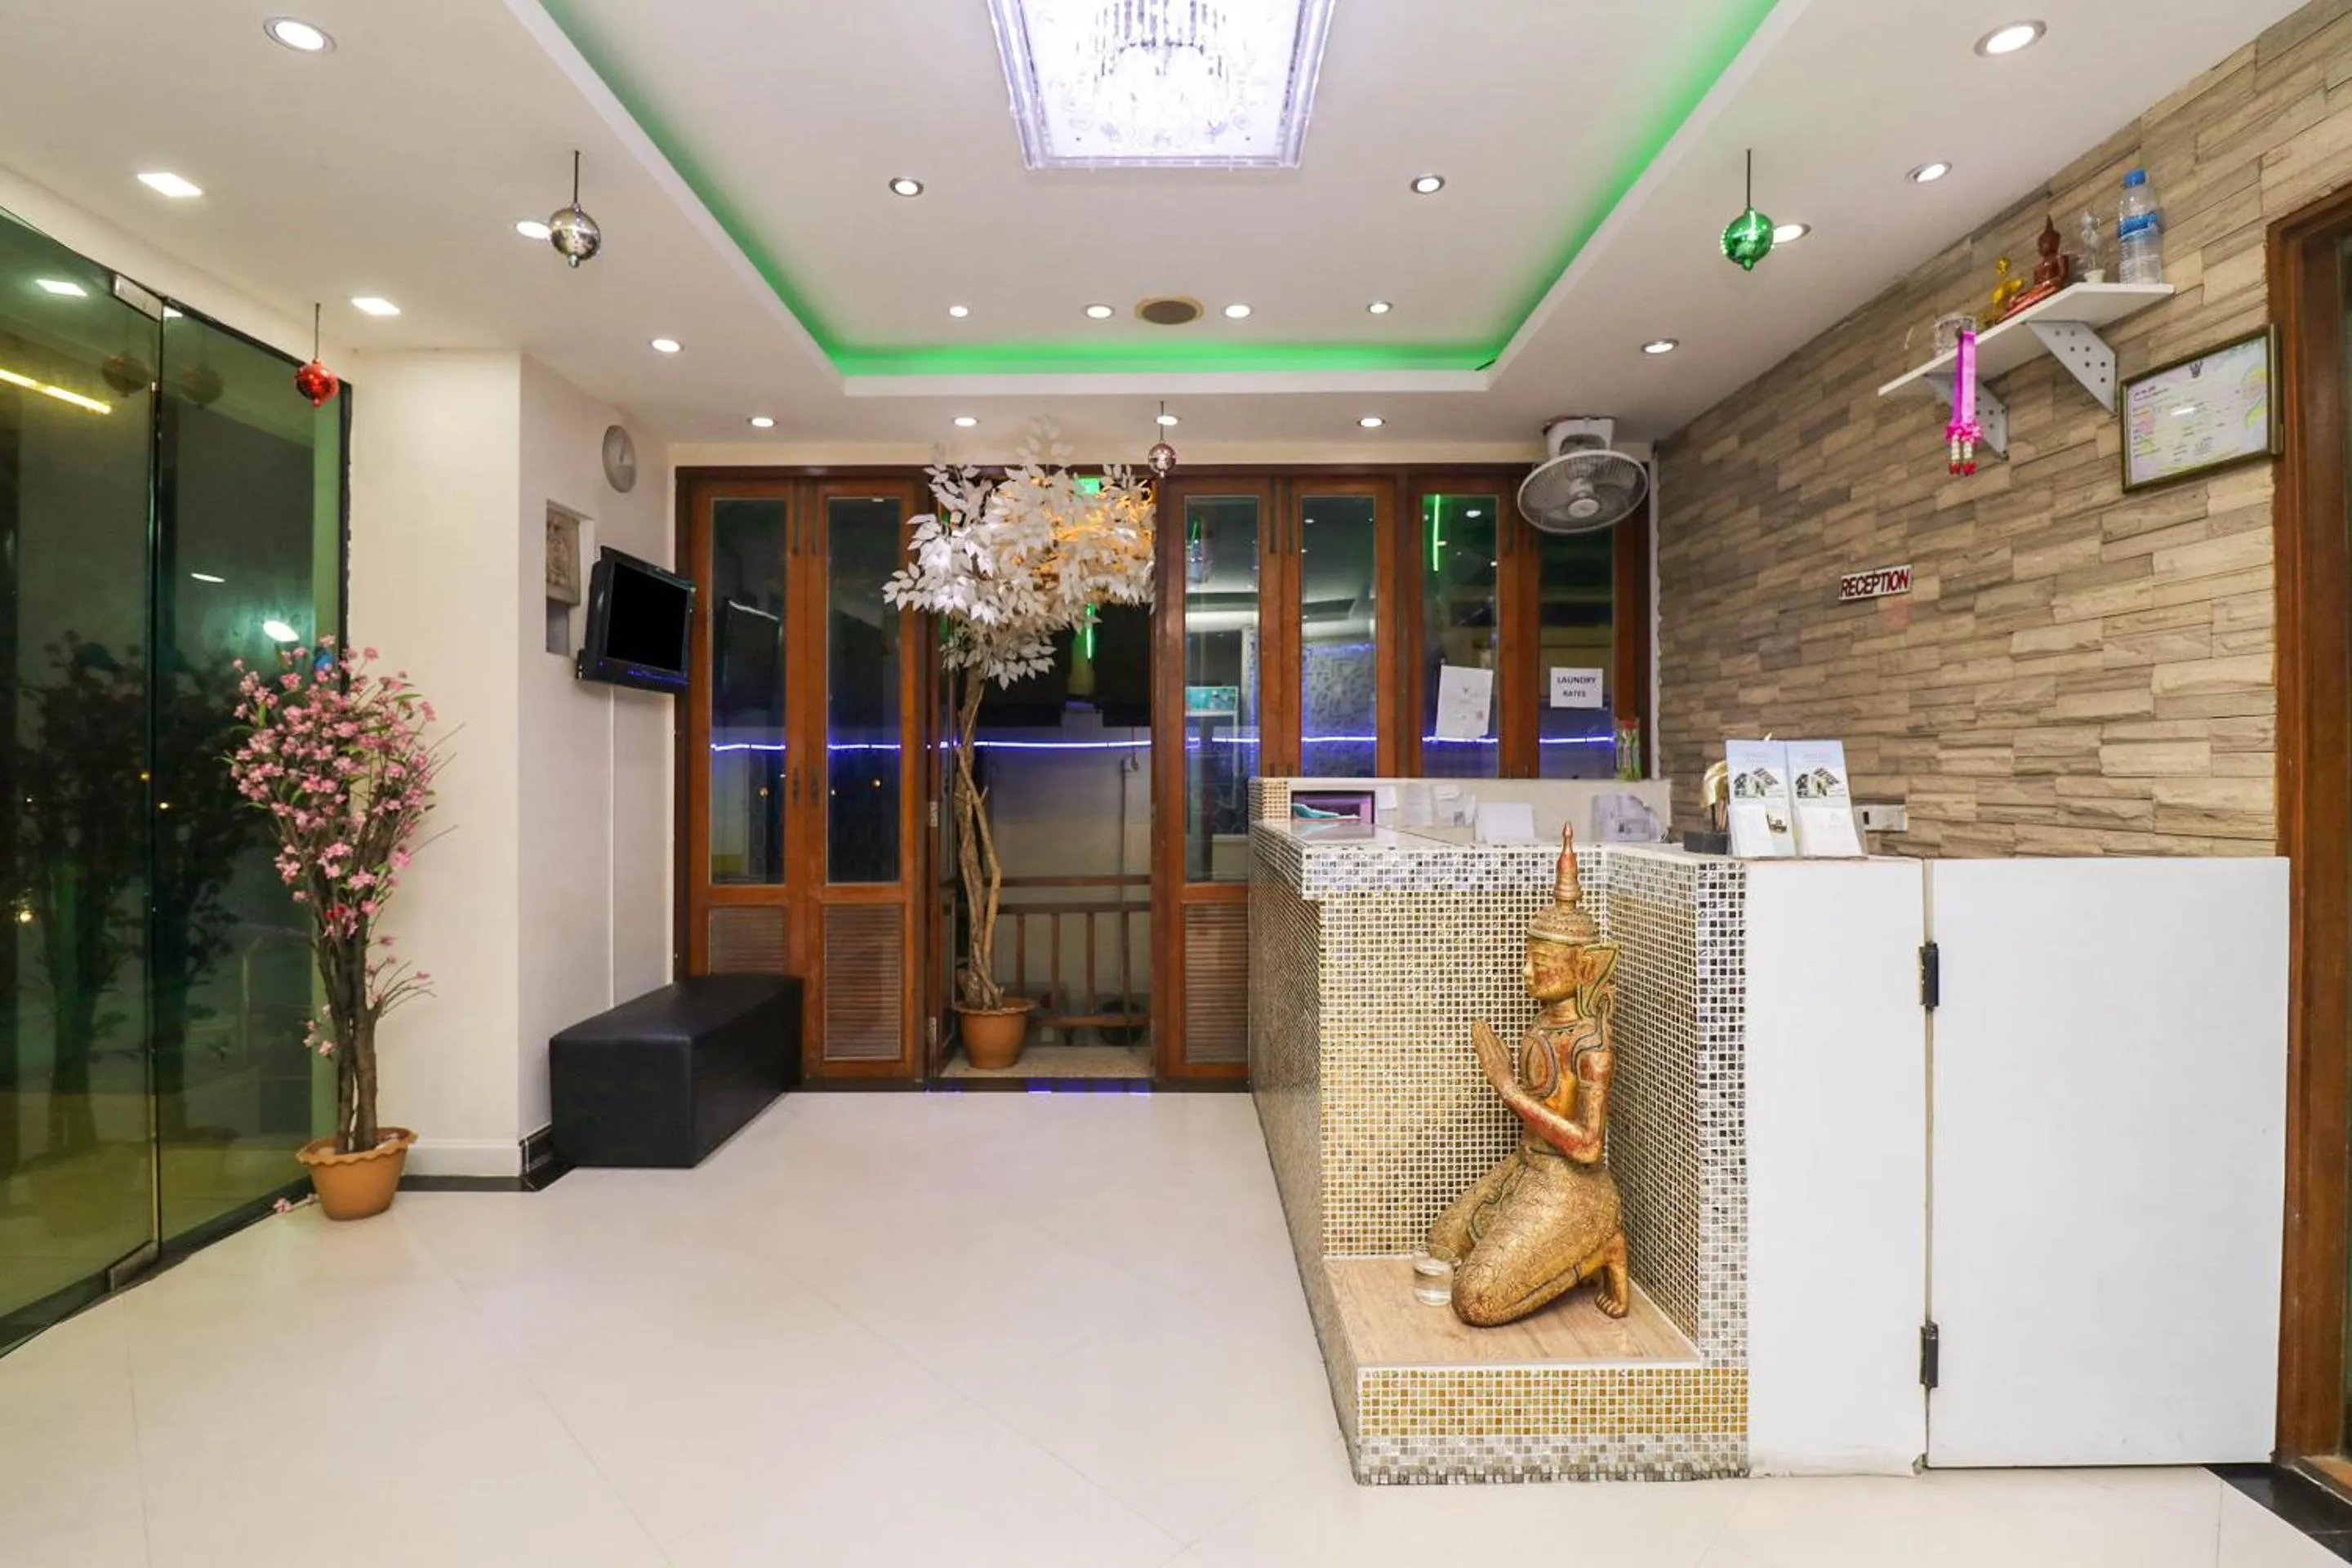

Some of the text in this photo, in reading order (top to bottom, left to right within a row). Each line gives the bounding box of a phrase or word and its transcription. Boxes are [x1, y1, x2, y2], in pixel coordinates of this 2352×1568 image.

[1840, 569, 1910, 598] RECEPTION
[1557, 676, 1597, 684] LAUNDRY
[1563, 689, 1587, 697] RATES
